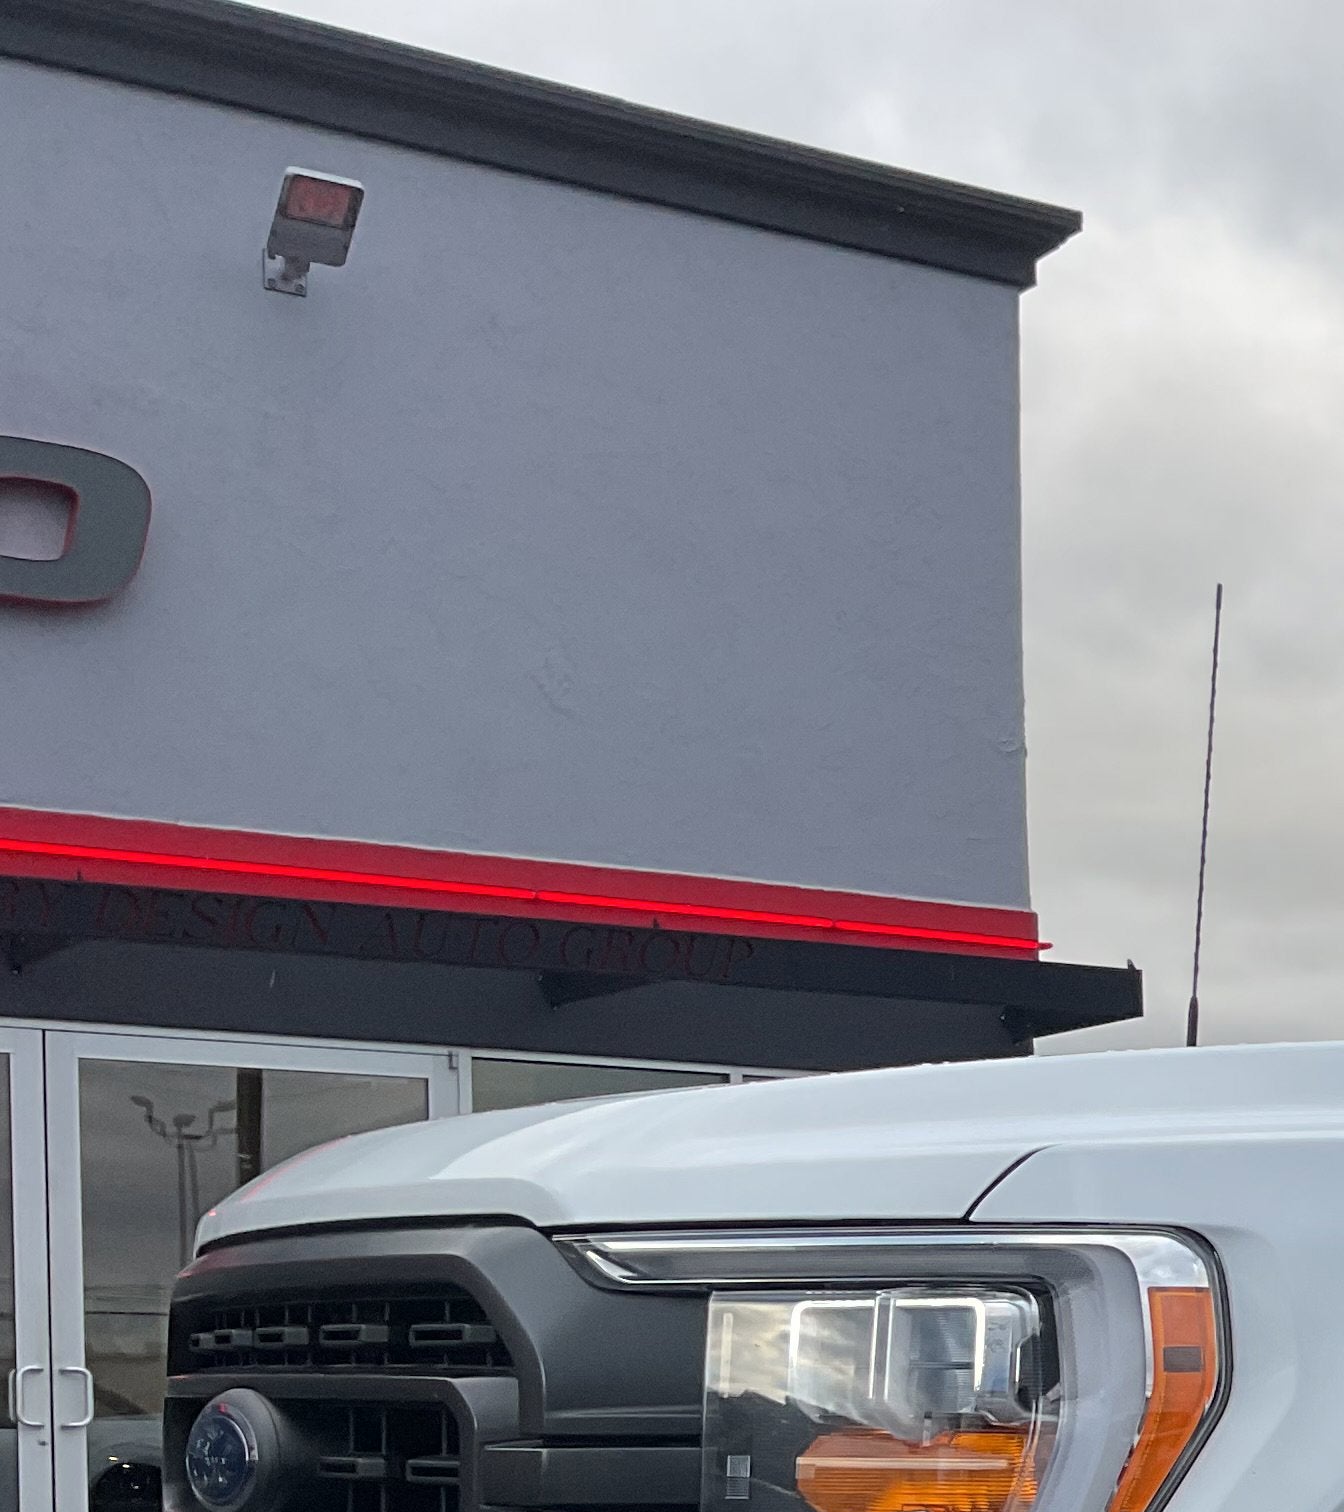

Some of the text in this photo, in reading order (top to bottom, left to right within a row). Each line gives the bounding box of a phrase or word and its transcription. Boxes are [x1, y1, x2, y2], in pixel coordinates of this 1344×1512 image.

[94, 886, 333, 946] DESIGN
[358, 909, 540, 965] AUTO
[560, 922, 754, 979] GROUP
